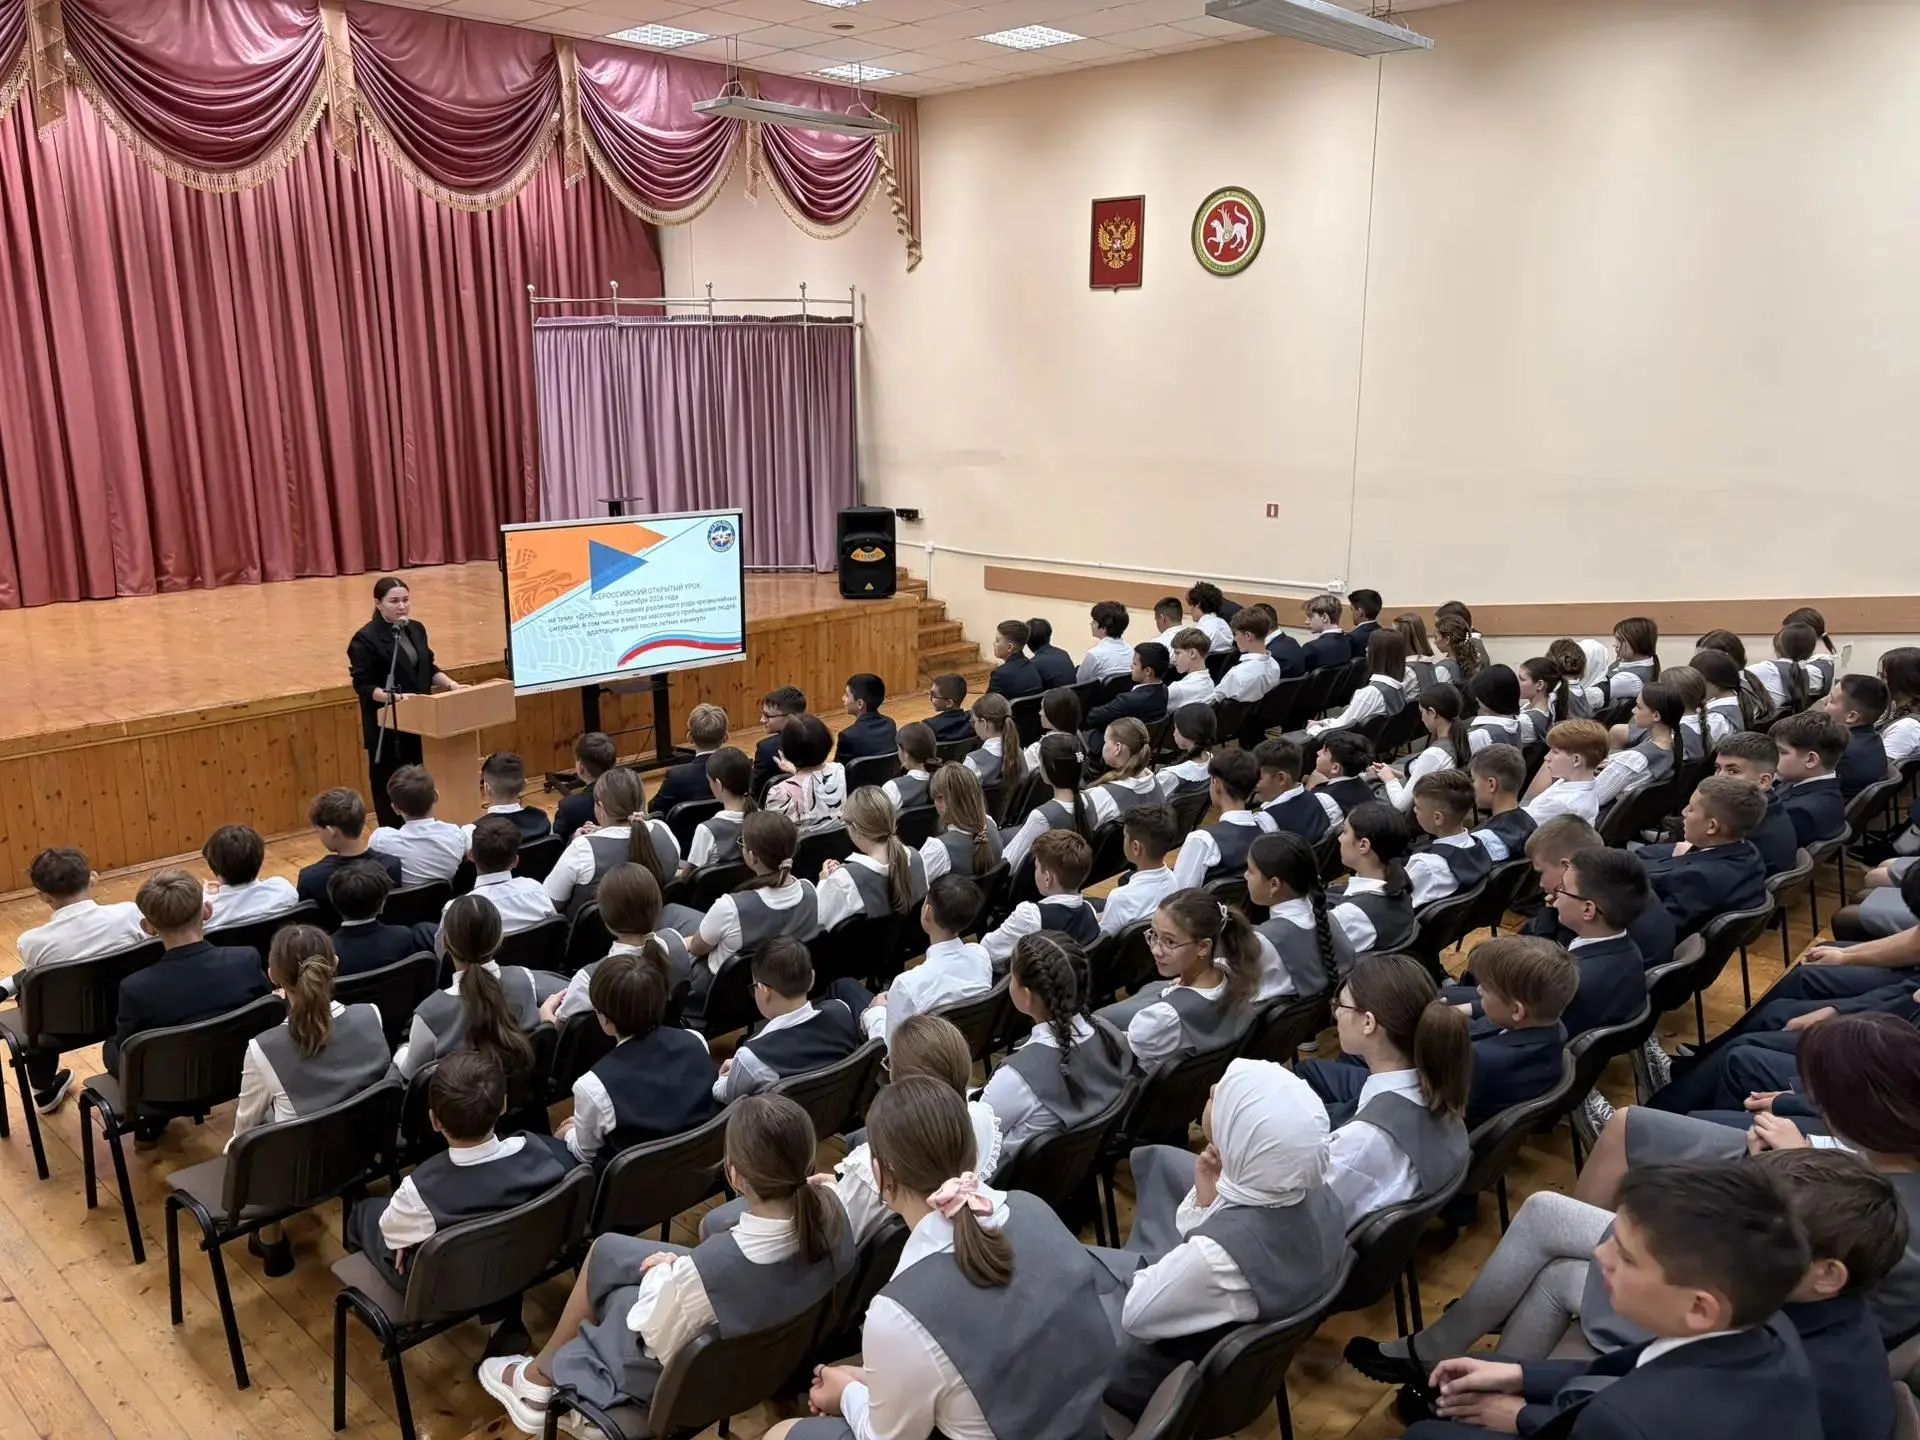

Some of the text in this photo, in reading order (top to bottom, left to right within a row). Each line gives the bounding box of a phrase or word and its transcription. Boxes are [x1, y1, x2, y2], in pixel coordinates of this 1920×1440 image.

[648, 584, 683, 594] ОТКРЫТЫЙ
[684, 582, 701, 591] УРОК
[620, 597, 648, 606] сентября
[680, 600, 695, 608] рода
[620, 624, 638, 632] детей
